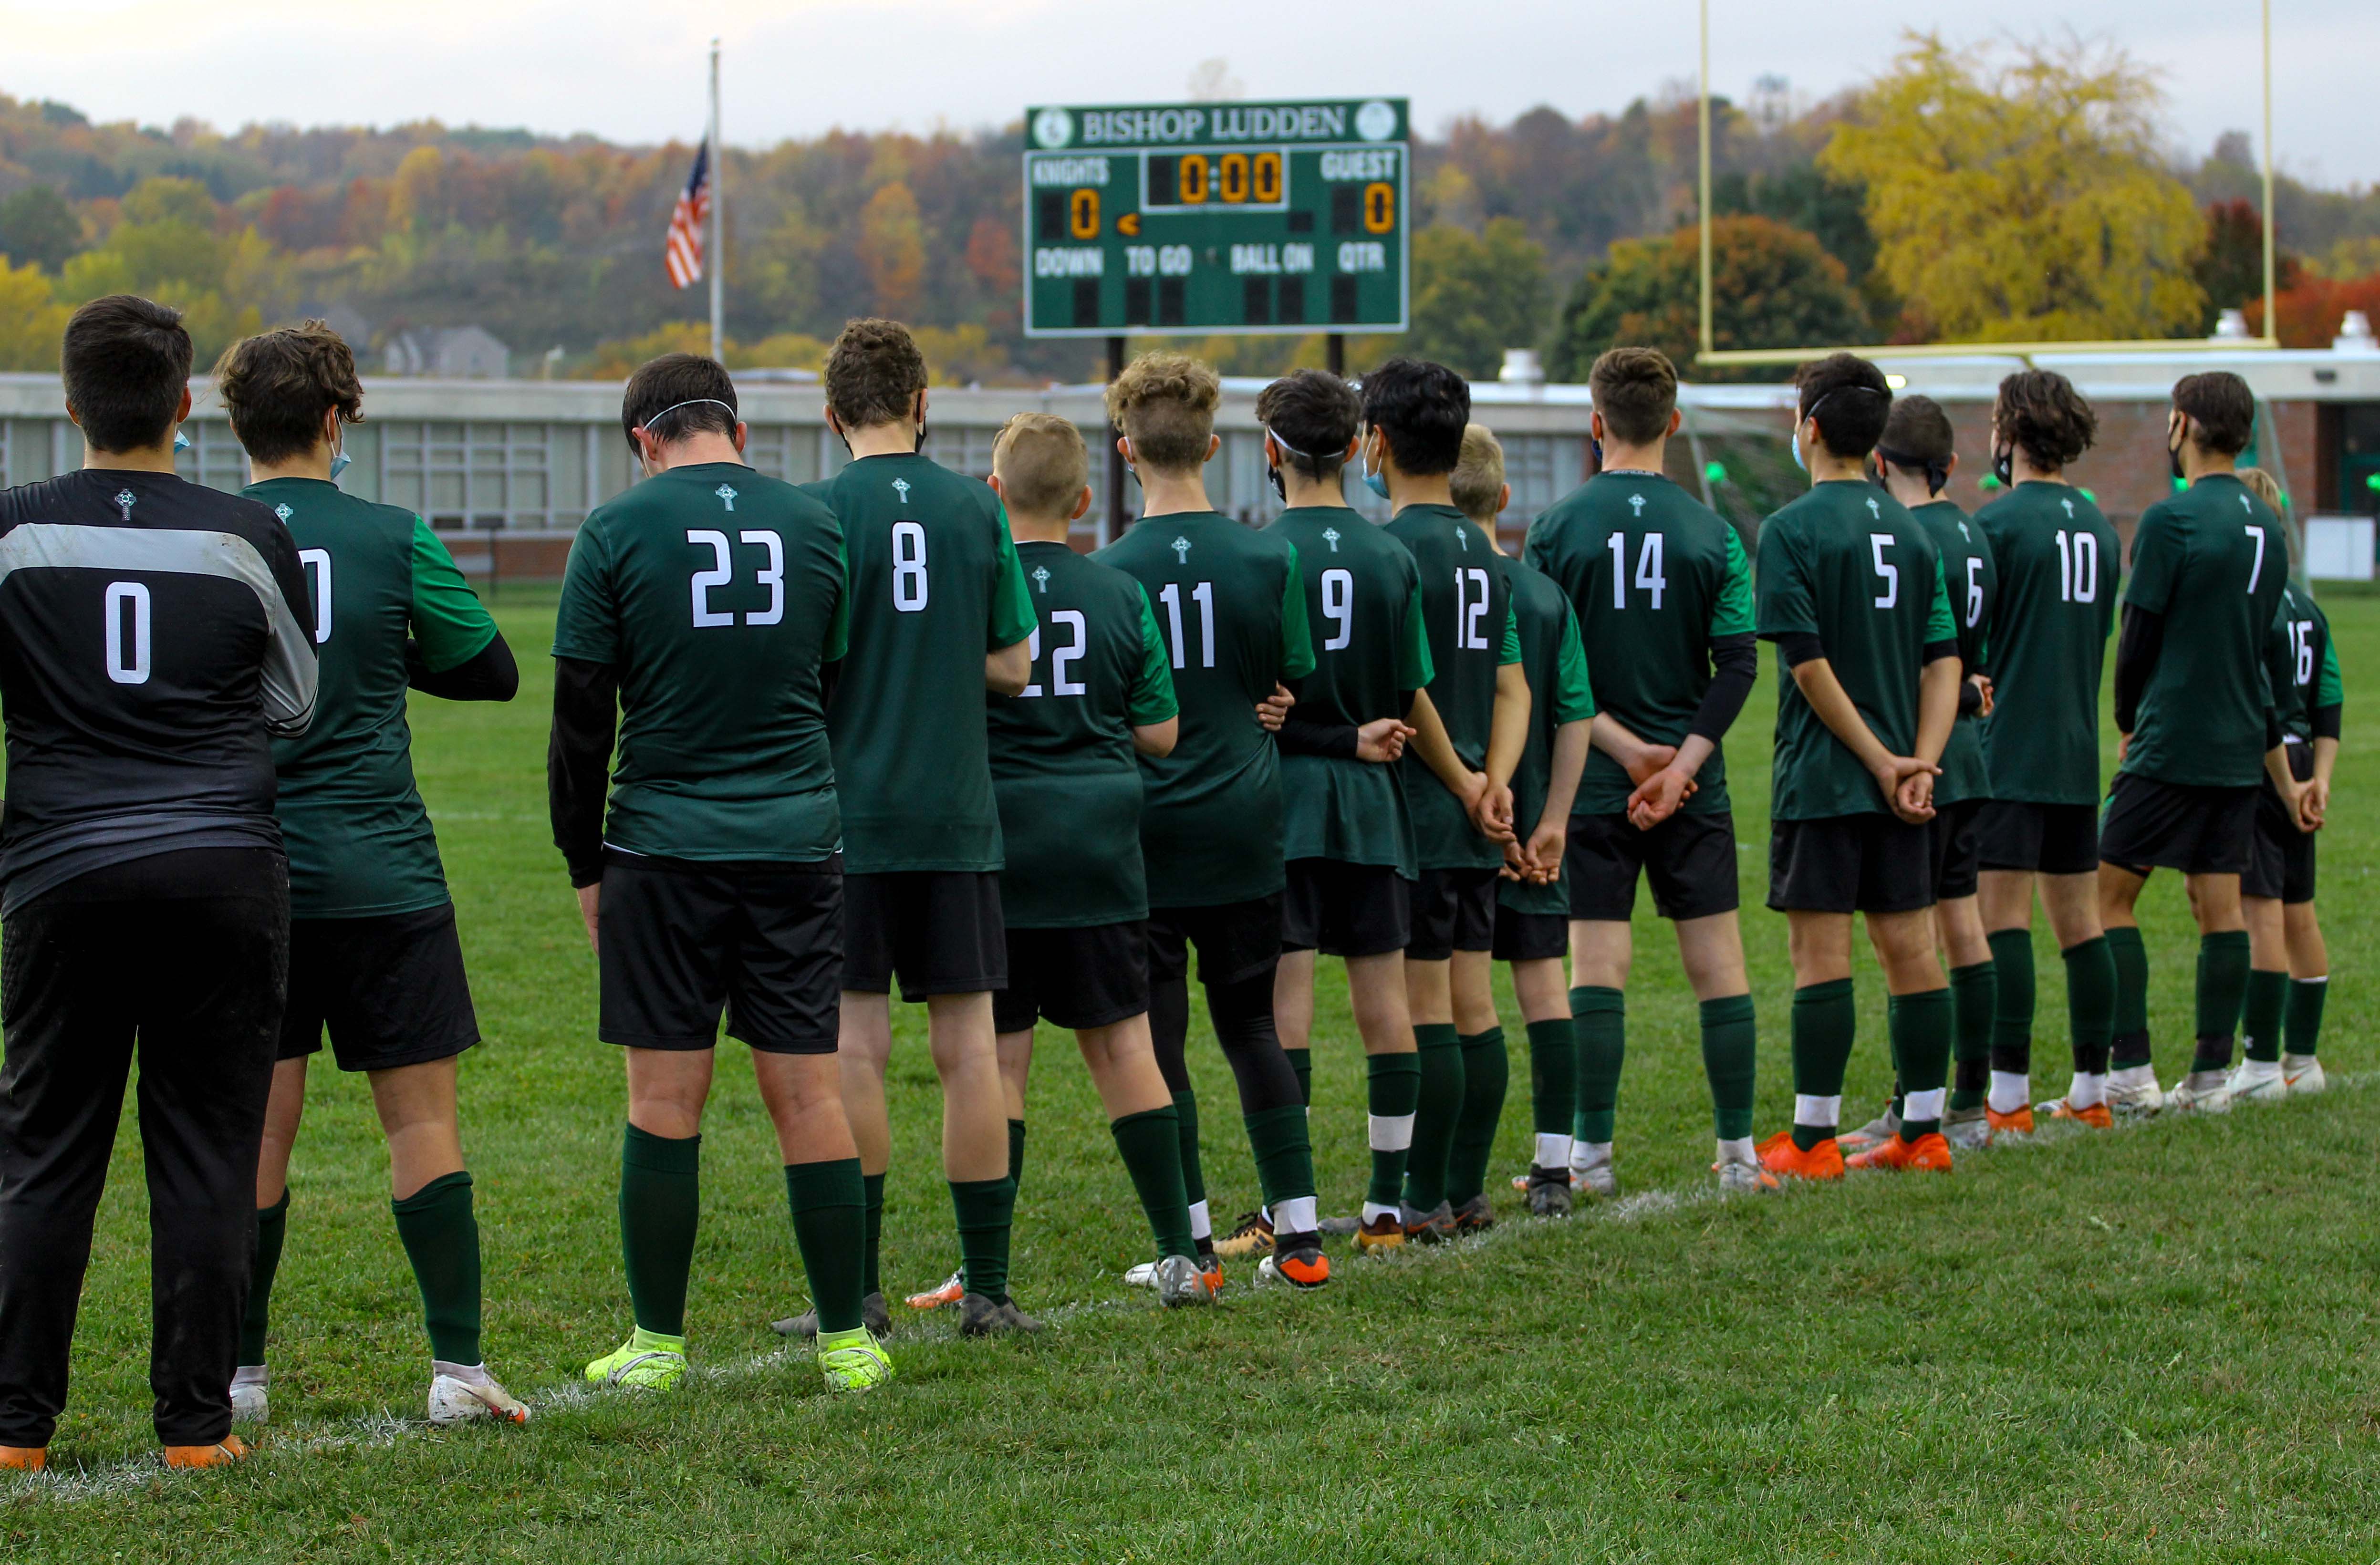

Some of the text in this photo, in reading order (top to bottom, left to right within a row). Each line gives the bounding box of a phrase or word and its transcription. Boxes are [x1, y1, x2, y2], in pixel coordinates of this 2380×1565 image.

[1082, 106, 1346, 142] BISHOP LUDDEN
[1032, 156, 1111, 187] KNIGHTS
[1179, 151, 1282, 205] 0:00
[1320, 150, 1396, 180] GUEST
[1070, 188, 1100, 239] 0
[1364, 182, 1394, 234] 0
[1035, 247, 1104, 277] DOWN
[1125, 245, 1192, 275] TO GO
[1230, 243, 1314, 273] BALL ON
[1338, 241, 1385, 272] QTR
[686, 529, 784, 628] 23
[892, 521, 928, 612] 8
[1607, 531, 1666, 610] 14
[1870, 533, 1898, 608] 5
[1966, 557, 1984, 629] 6
[2055, 529, 2098, 603] 10
[2245, 525, 2265, 594] 7
[105, 581, 151, 684] 0
[1159, 581, 1215, 669] 11
[1321, 569, 1353, 651] 9
[1455, 567, 1489, 650] 12
[2287, 620, 2313, 686] 16
